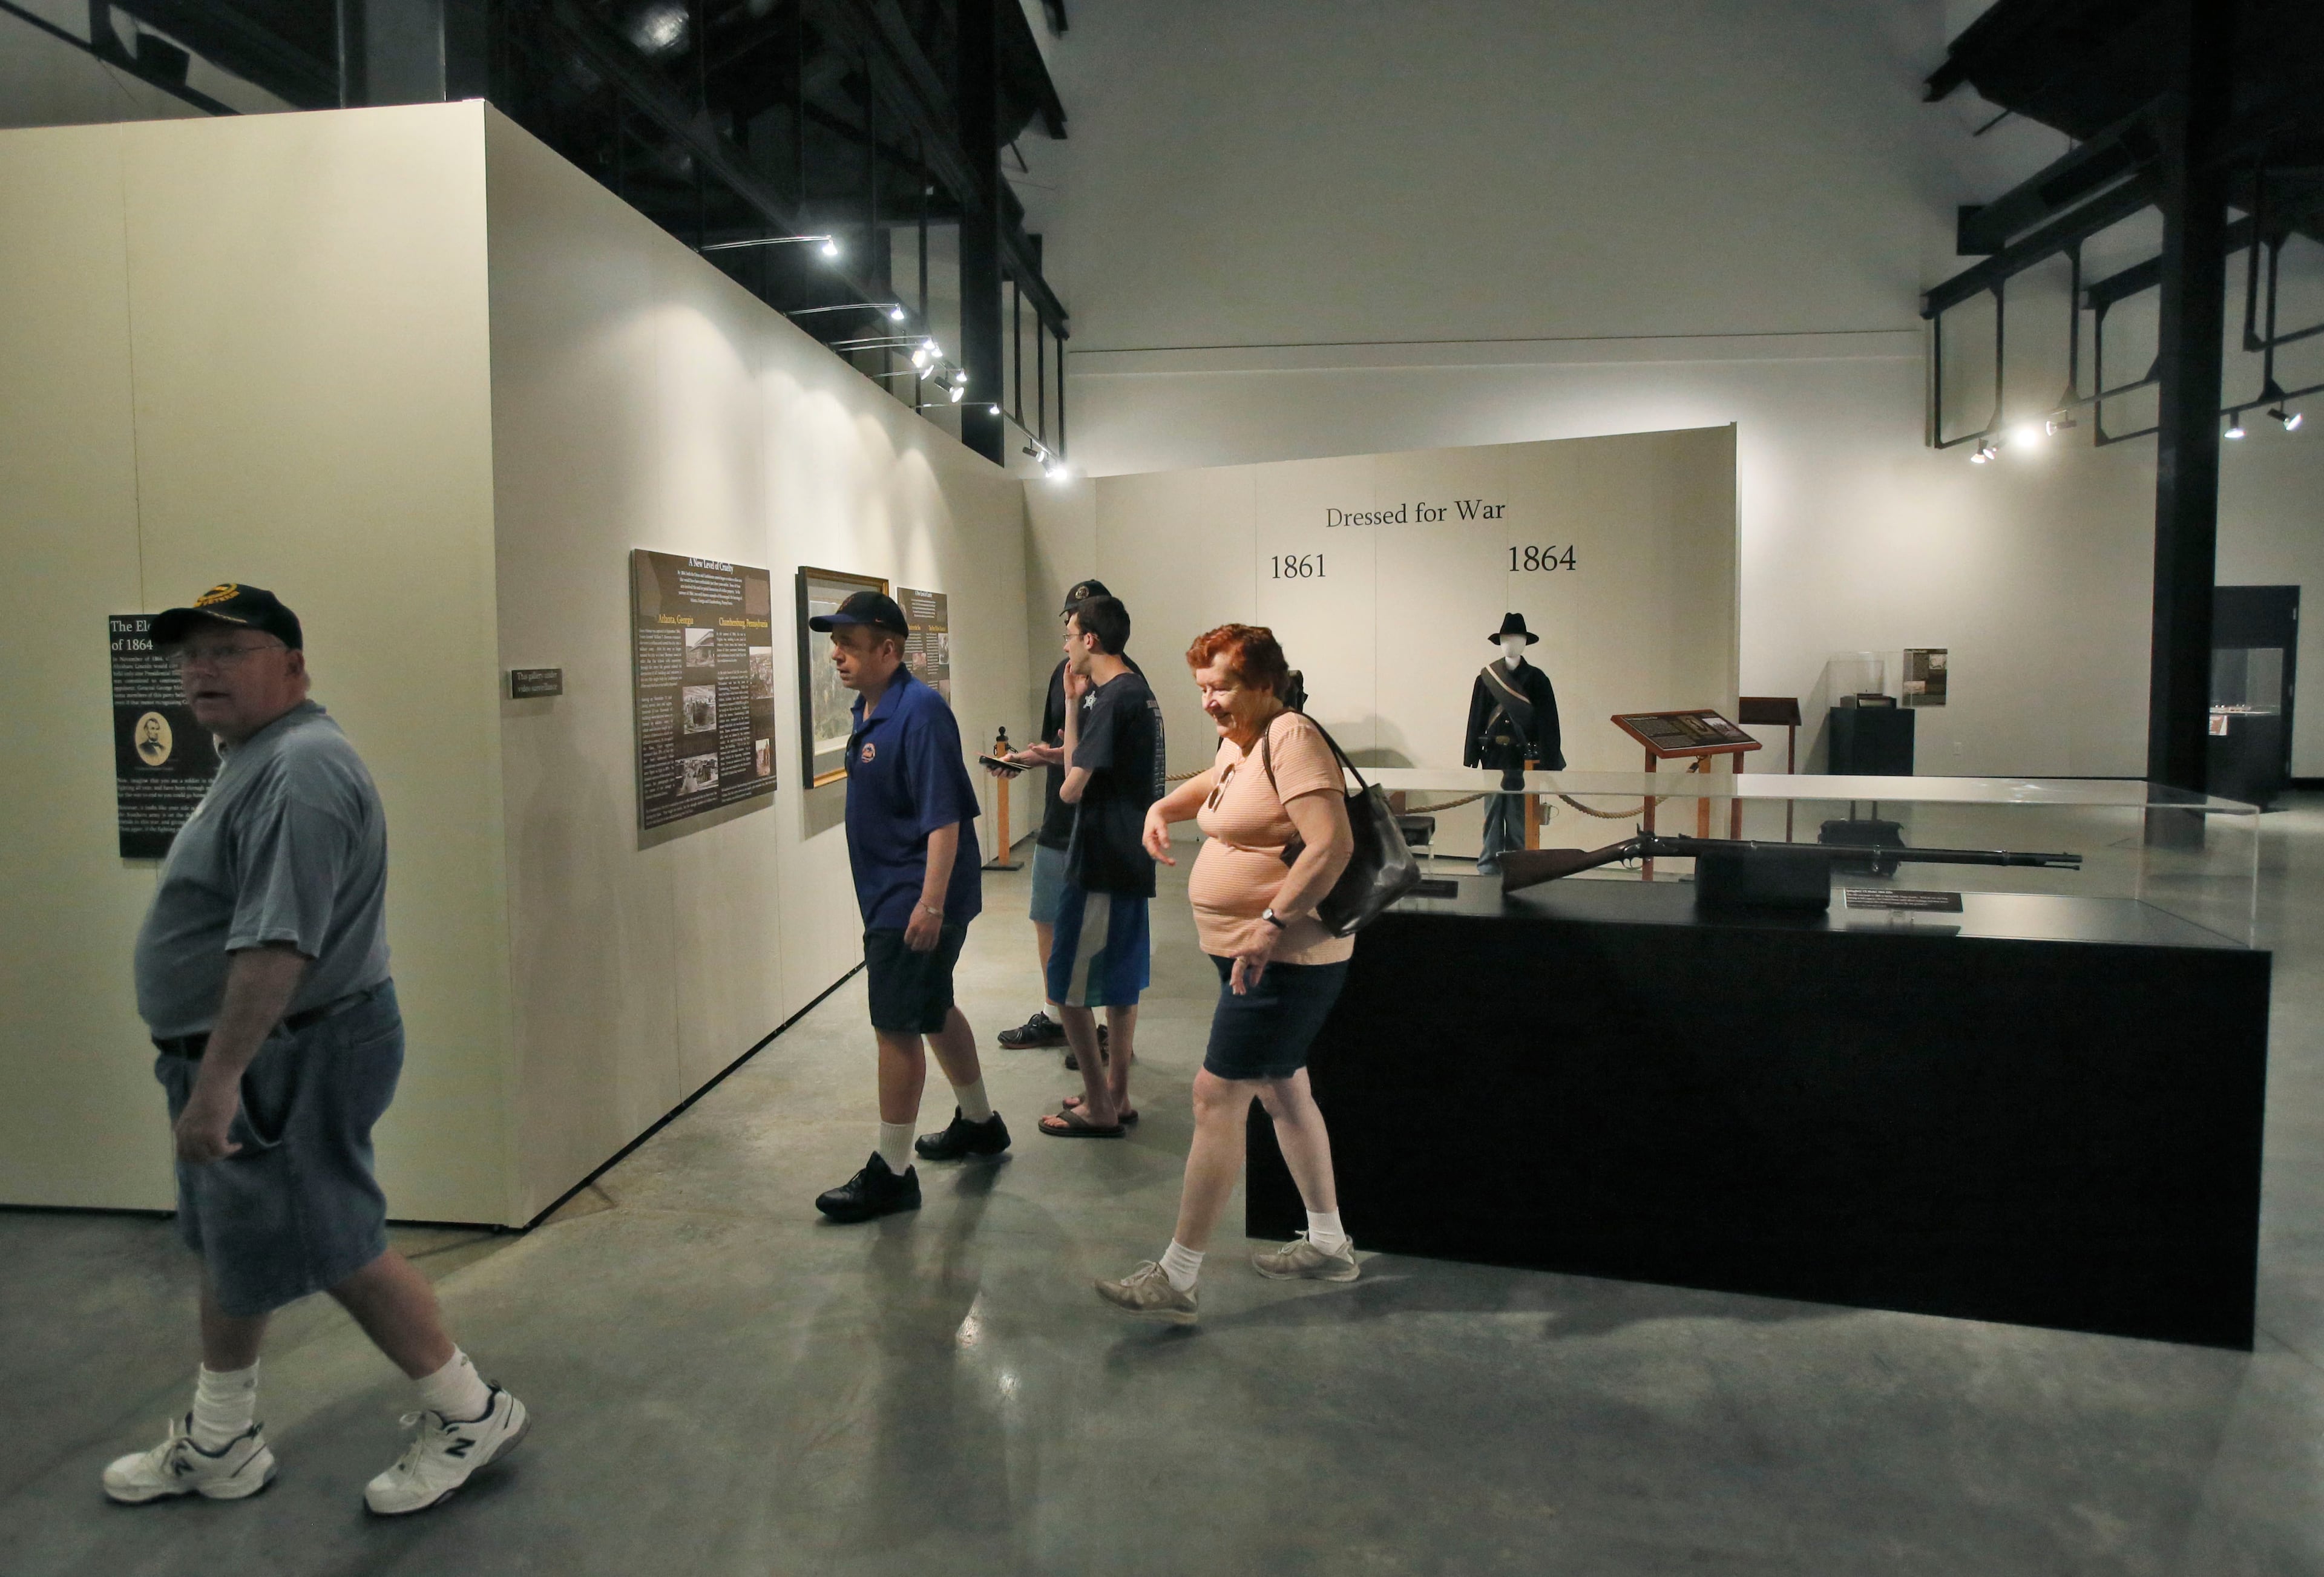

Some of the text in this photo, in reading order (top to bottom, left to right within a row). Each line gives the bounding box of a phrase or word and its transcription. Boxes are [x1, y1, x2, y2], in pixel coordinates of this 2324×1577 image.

[1325, 499, 1506, 528] Dressed for War
[1271, 545, 1577, 579] 1861 1864
[110, 620, 133, 632] The
[677, 614, 694, 626] Georgia
[111, 639, 154, 651] of 1864
